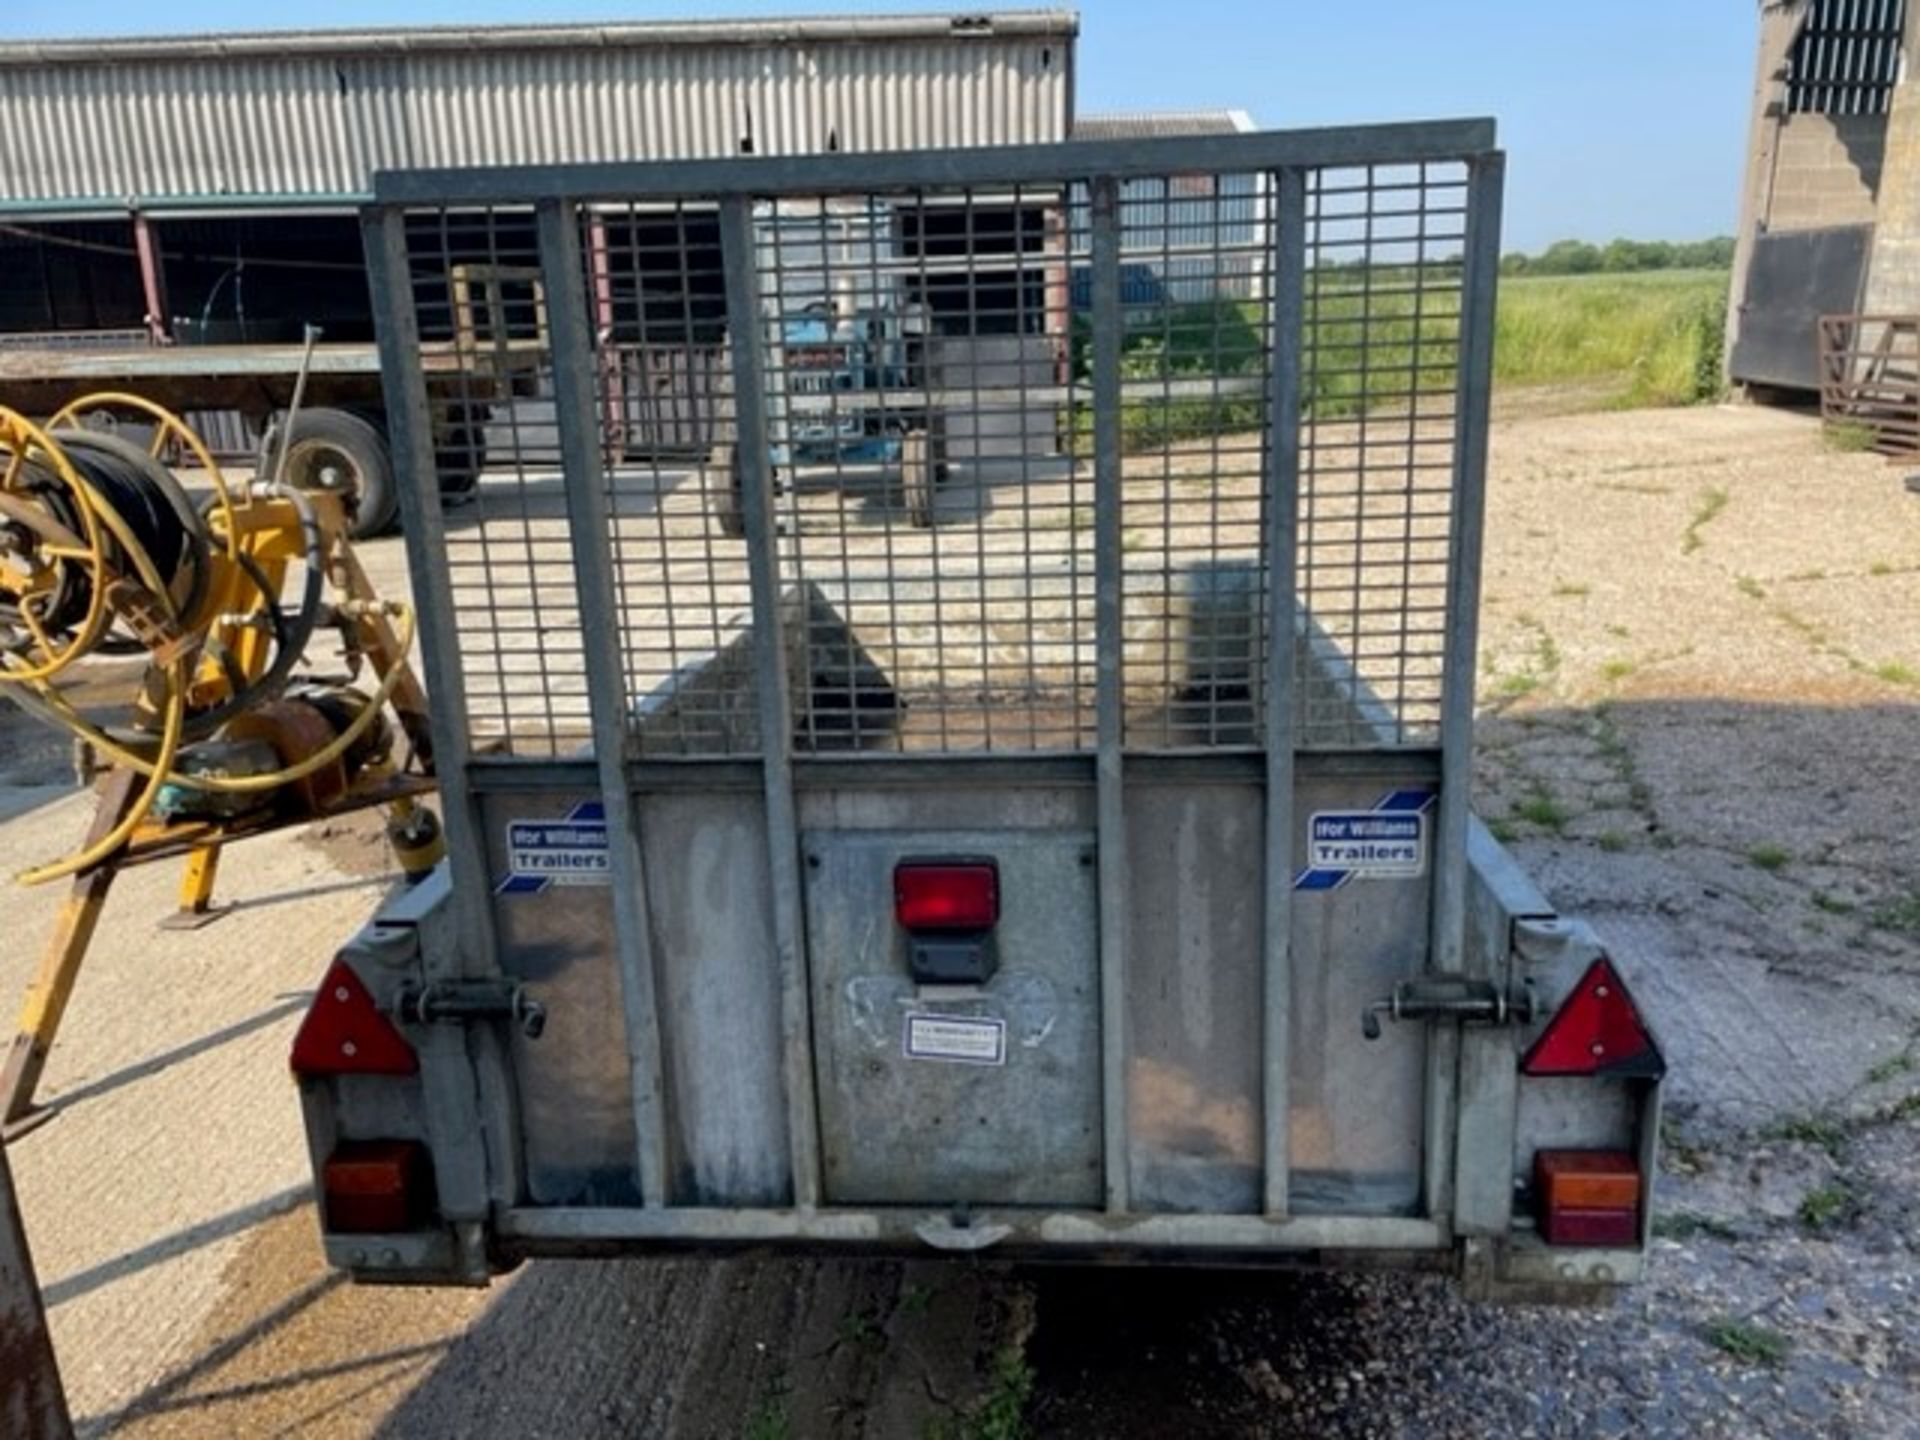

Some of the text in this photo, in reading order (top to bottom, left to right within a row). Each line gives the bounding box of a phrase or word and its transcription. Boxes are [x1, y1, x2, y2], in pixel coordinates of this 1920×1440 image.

[1349, 821, 1417, 836] Williams
[1317, 844, 1414, 859] Trailers
[517, 854, 607, 868] Trailers
